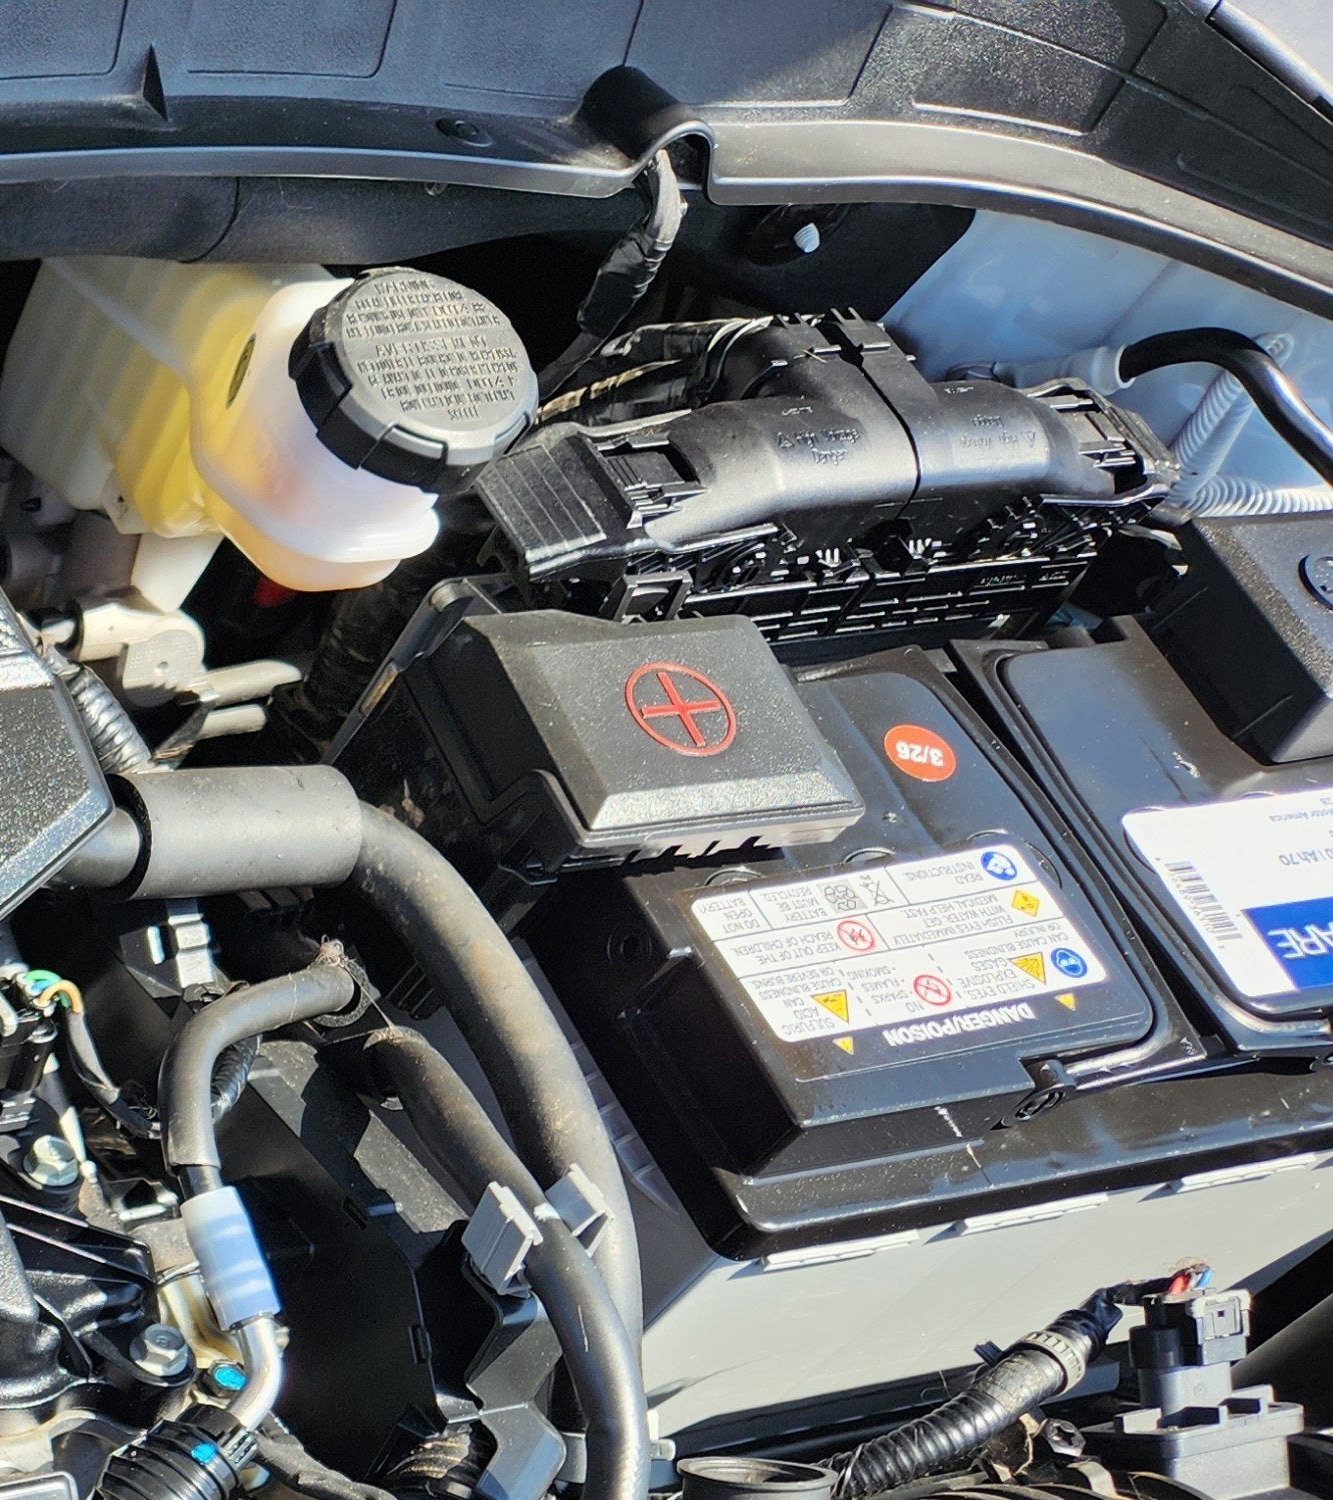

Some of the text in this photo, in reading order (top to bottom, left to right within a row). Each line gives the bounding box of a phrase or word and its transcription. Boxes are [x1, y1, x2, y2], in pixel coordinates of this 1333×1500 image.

[893, 926, 957, 946] IMMEDIATELY
[957, 968, 1017, 988] EXPLOSIVE
[793, 1006, 820, 1020] ACID
[906, 1001, 924, 1013] NO
[783, 1017, 835, 1036] SULFURIC
[883, 1002, 1036, 1047] DANGER/POISON
